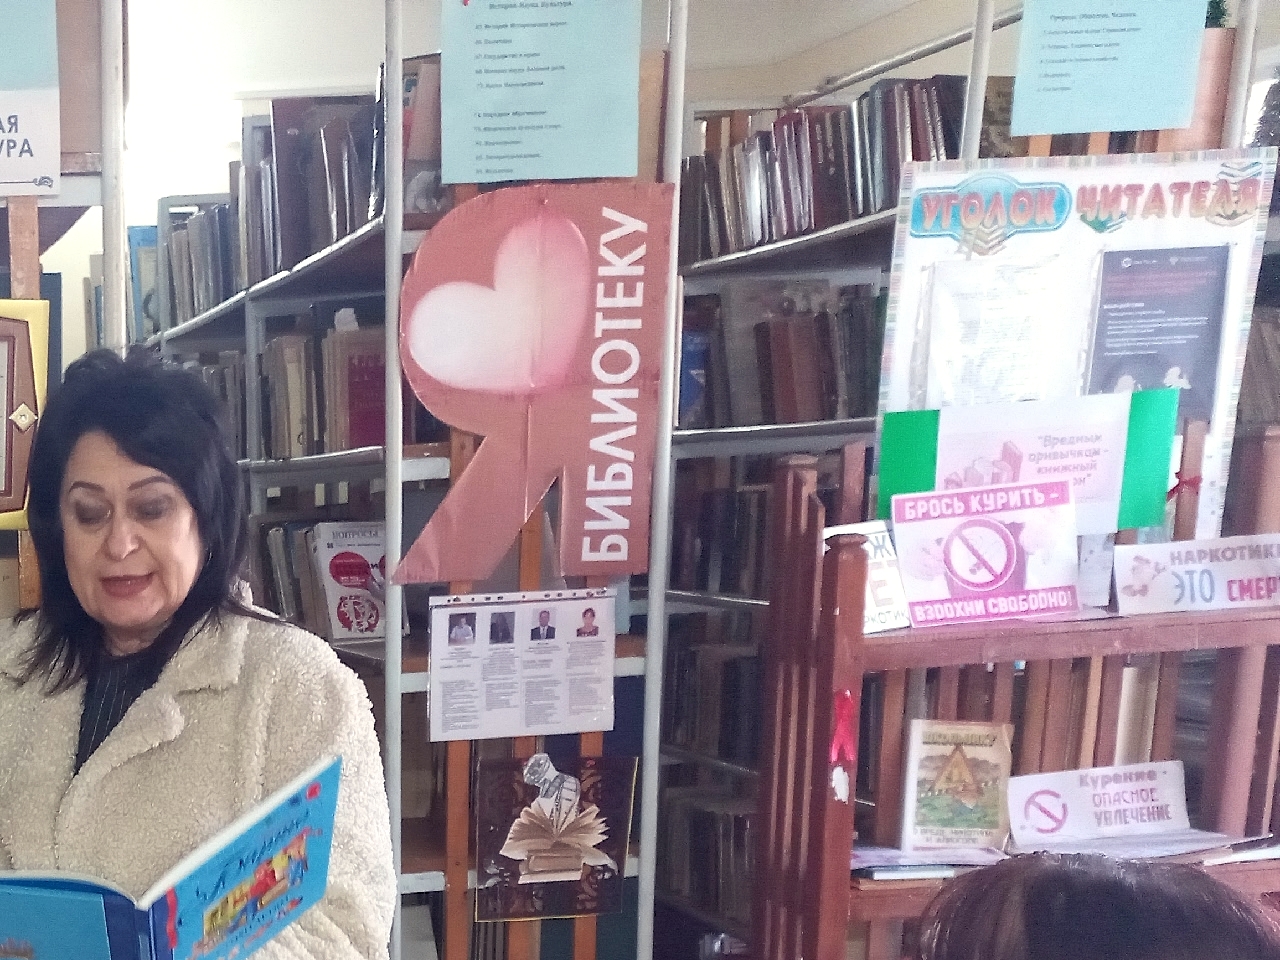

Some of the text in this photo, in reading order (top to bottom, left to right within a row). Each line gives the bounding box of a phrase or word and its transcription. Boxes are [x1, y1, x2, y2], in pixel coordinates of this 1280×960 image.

[920, 178, 1262, 232] УГОЛОК ЧИТАТЕЛЯ
[581, 206, 649, 563] БИБЛИОТЕКУ
[904, 496, 965, 520] БРОСЬ
[970, 487, 1045, 513] КУРИТЬ
[1172, 568, 1280, 605] ЭТО СМЕР
[914, 590, 1073, 623] ВЗДОХНИ СВОБОДНО!
[1078, 769, 1158, 789] Курение
[1092, 787, 1160, 808] ОПАСНОЕ
[1094, 803, 1173, 827] УВЛЕЧЕНИЕ
